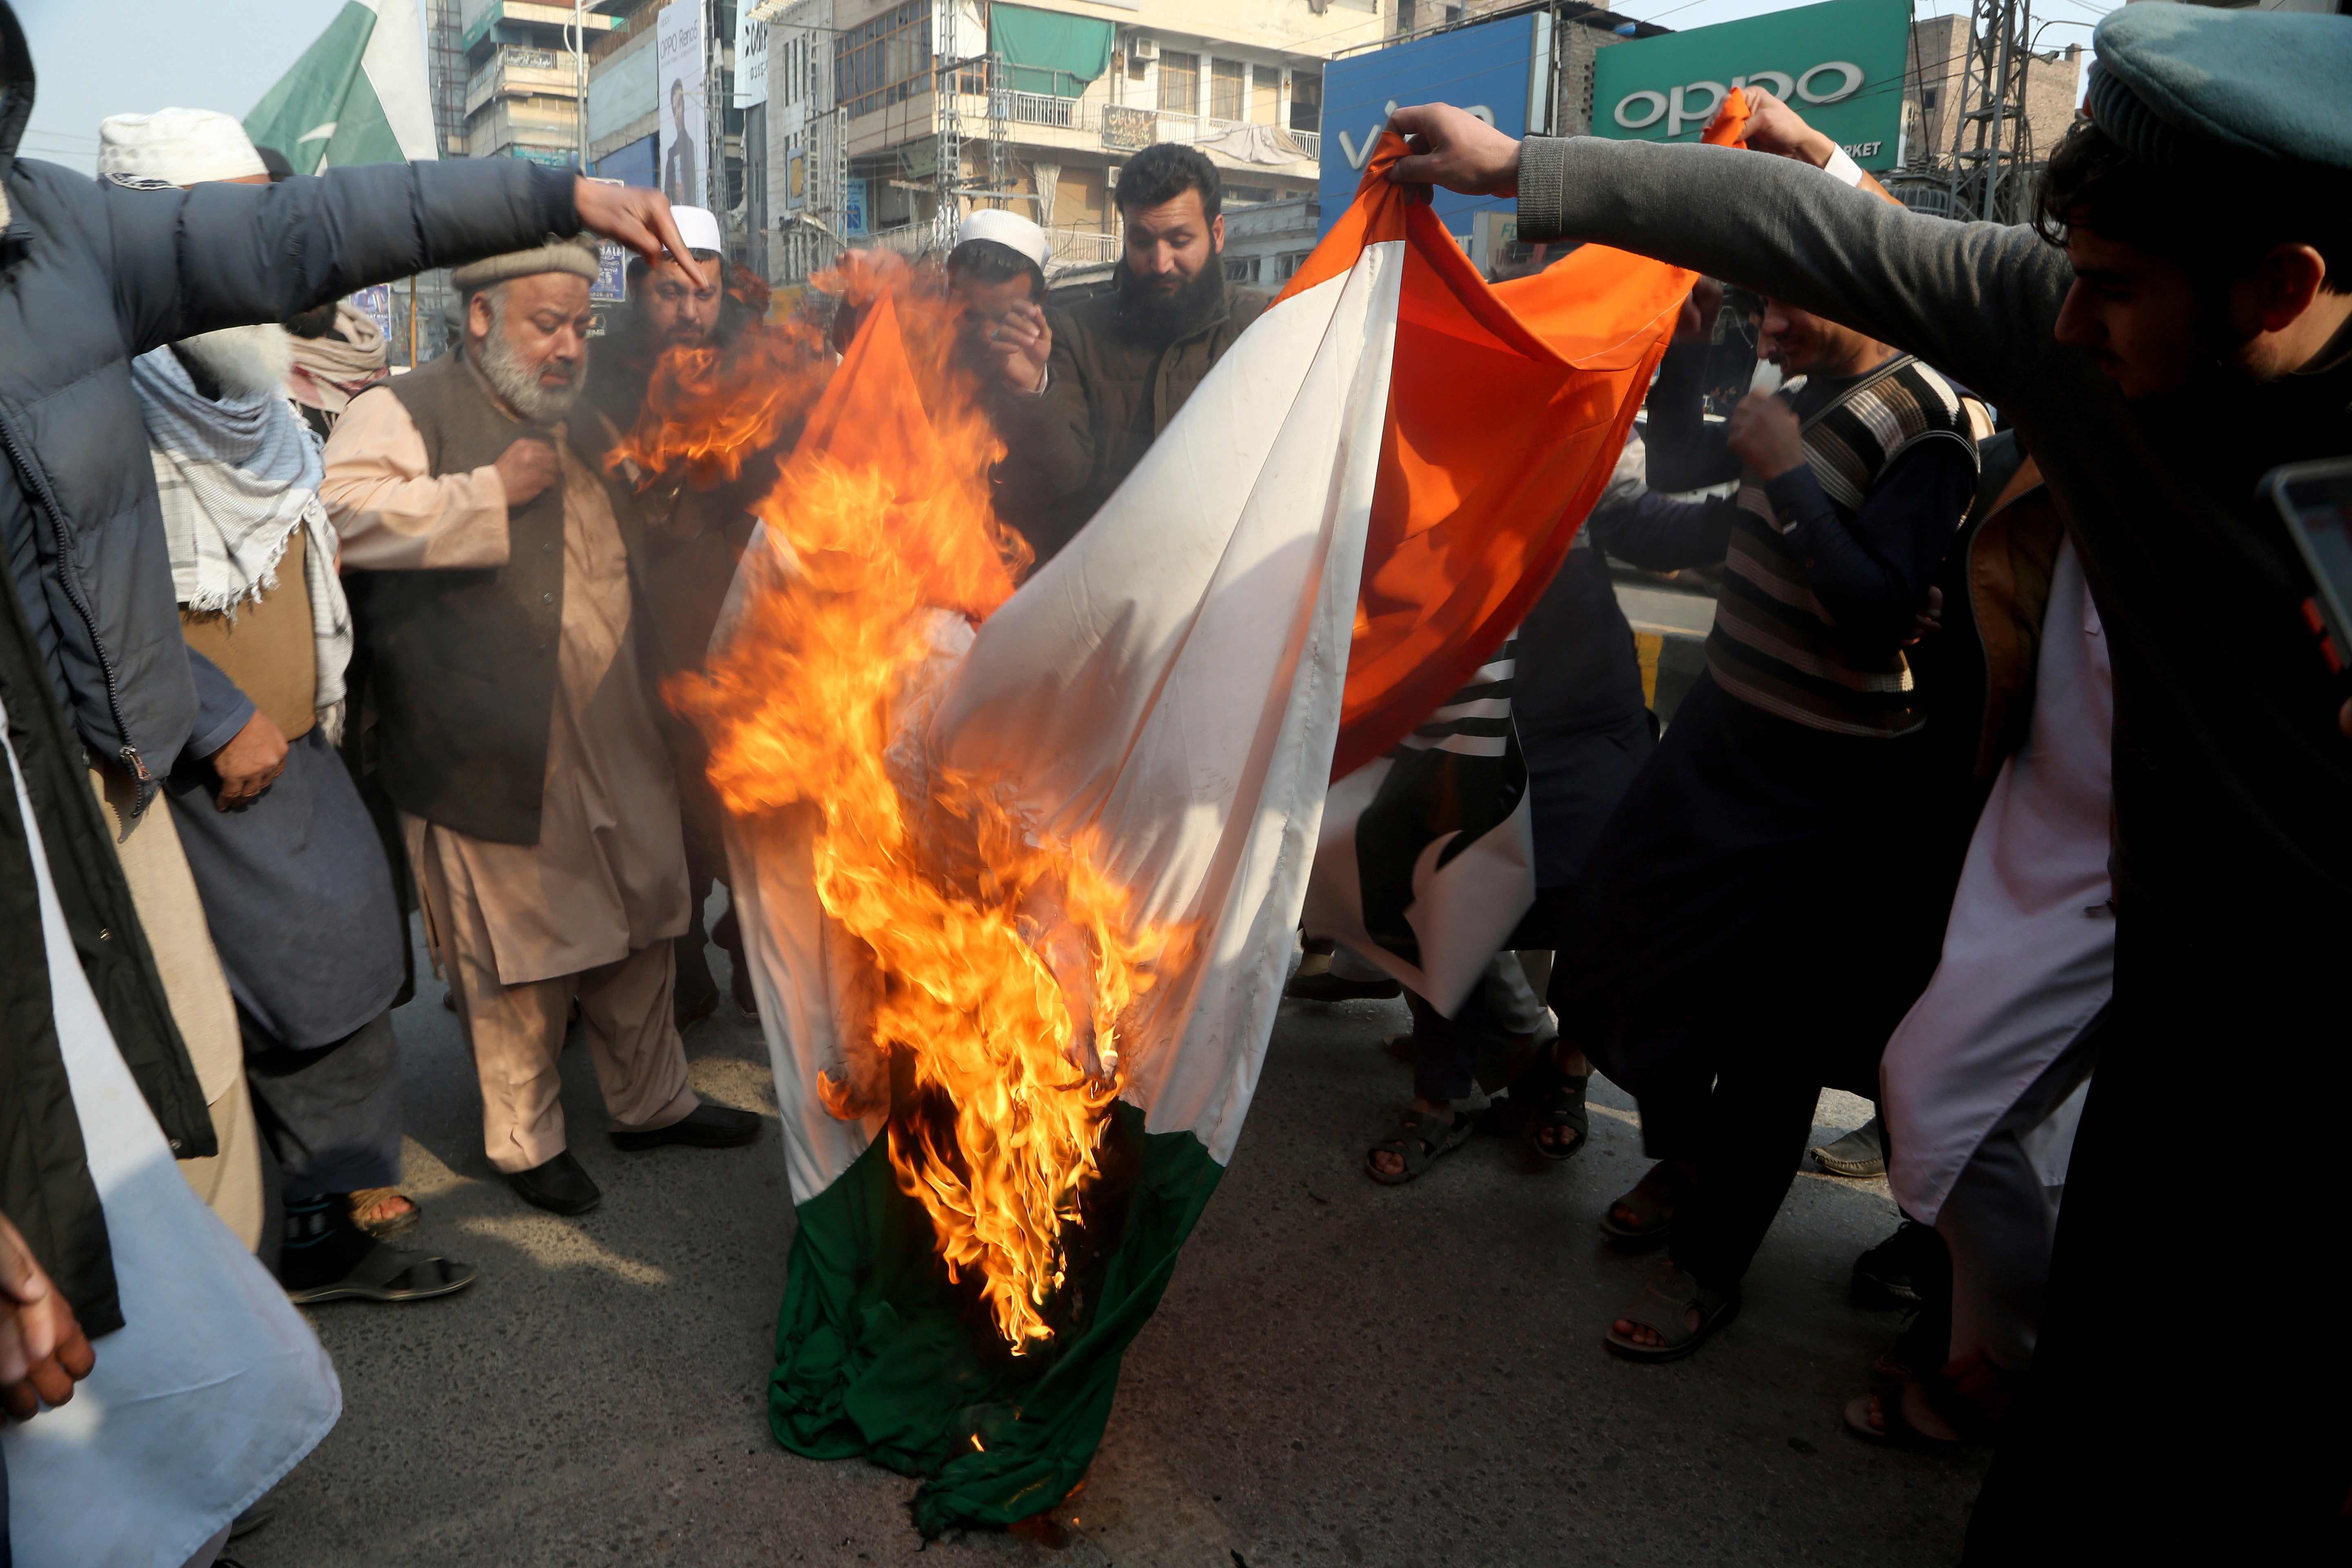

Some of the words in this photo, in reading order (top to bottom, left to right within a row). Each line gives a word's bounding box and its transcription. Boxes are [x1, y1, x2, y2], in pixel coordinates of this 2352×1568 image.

[661, 33, 677, 59] OPPO
[679, 19, 698, 49] Reno5
[1844, 141, 1882, 158] RKET
